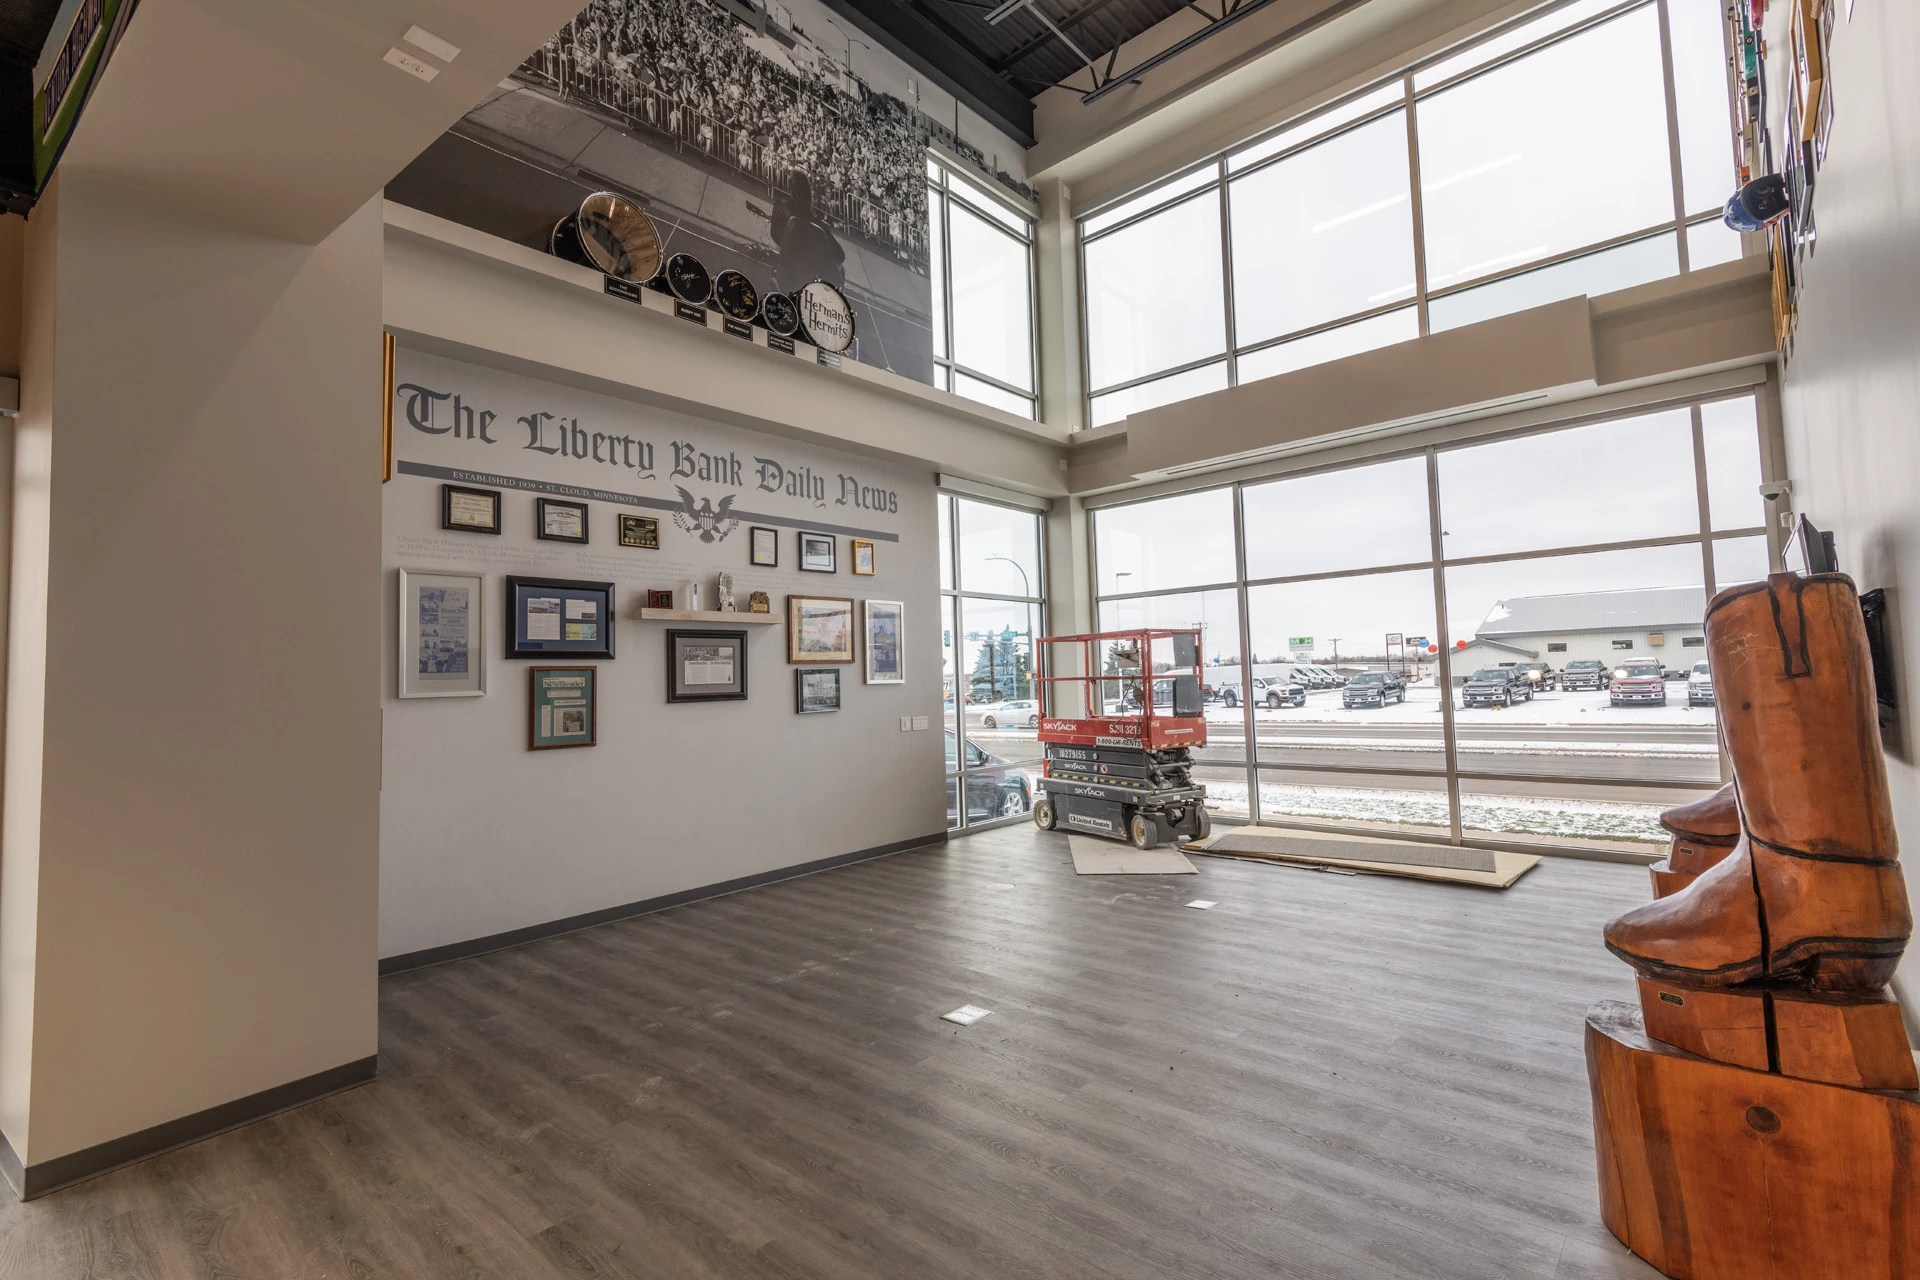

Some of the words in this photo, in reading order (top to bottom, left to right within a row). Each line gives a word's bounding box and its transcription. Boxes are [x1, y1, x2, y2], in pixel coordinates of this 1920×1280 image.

[808, 310, 848, 338] Hermits
[396, 382, 498, 444] The
[517, 411, 656, 480] Liberty
[670, 440, 743, 487] Bank
[754, 456, 826, 509] Daily
[835, 474, 898, 514] News
[453, 471, 516, 486] ESTABLISHED
[546, 484, 558, 492] ST.
[560, 486, 591, 497] CLOUD,
[594, 492, 638, 504] MINNESOTA
[1043, 721, 1077, 731] SKYJACK
[1074, 787, 1105, 797] SKYJACK
[1076, 816, 1092, 825] United
[1092, 820, 1110, 828] Rentals
